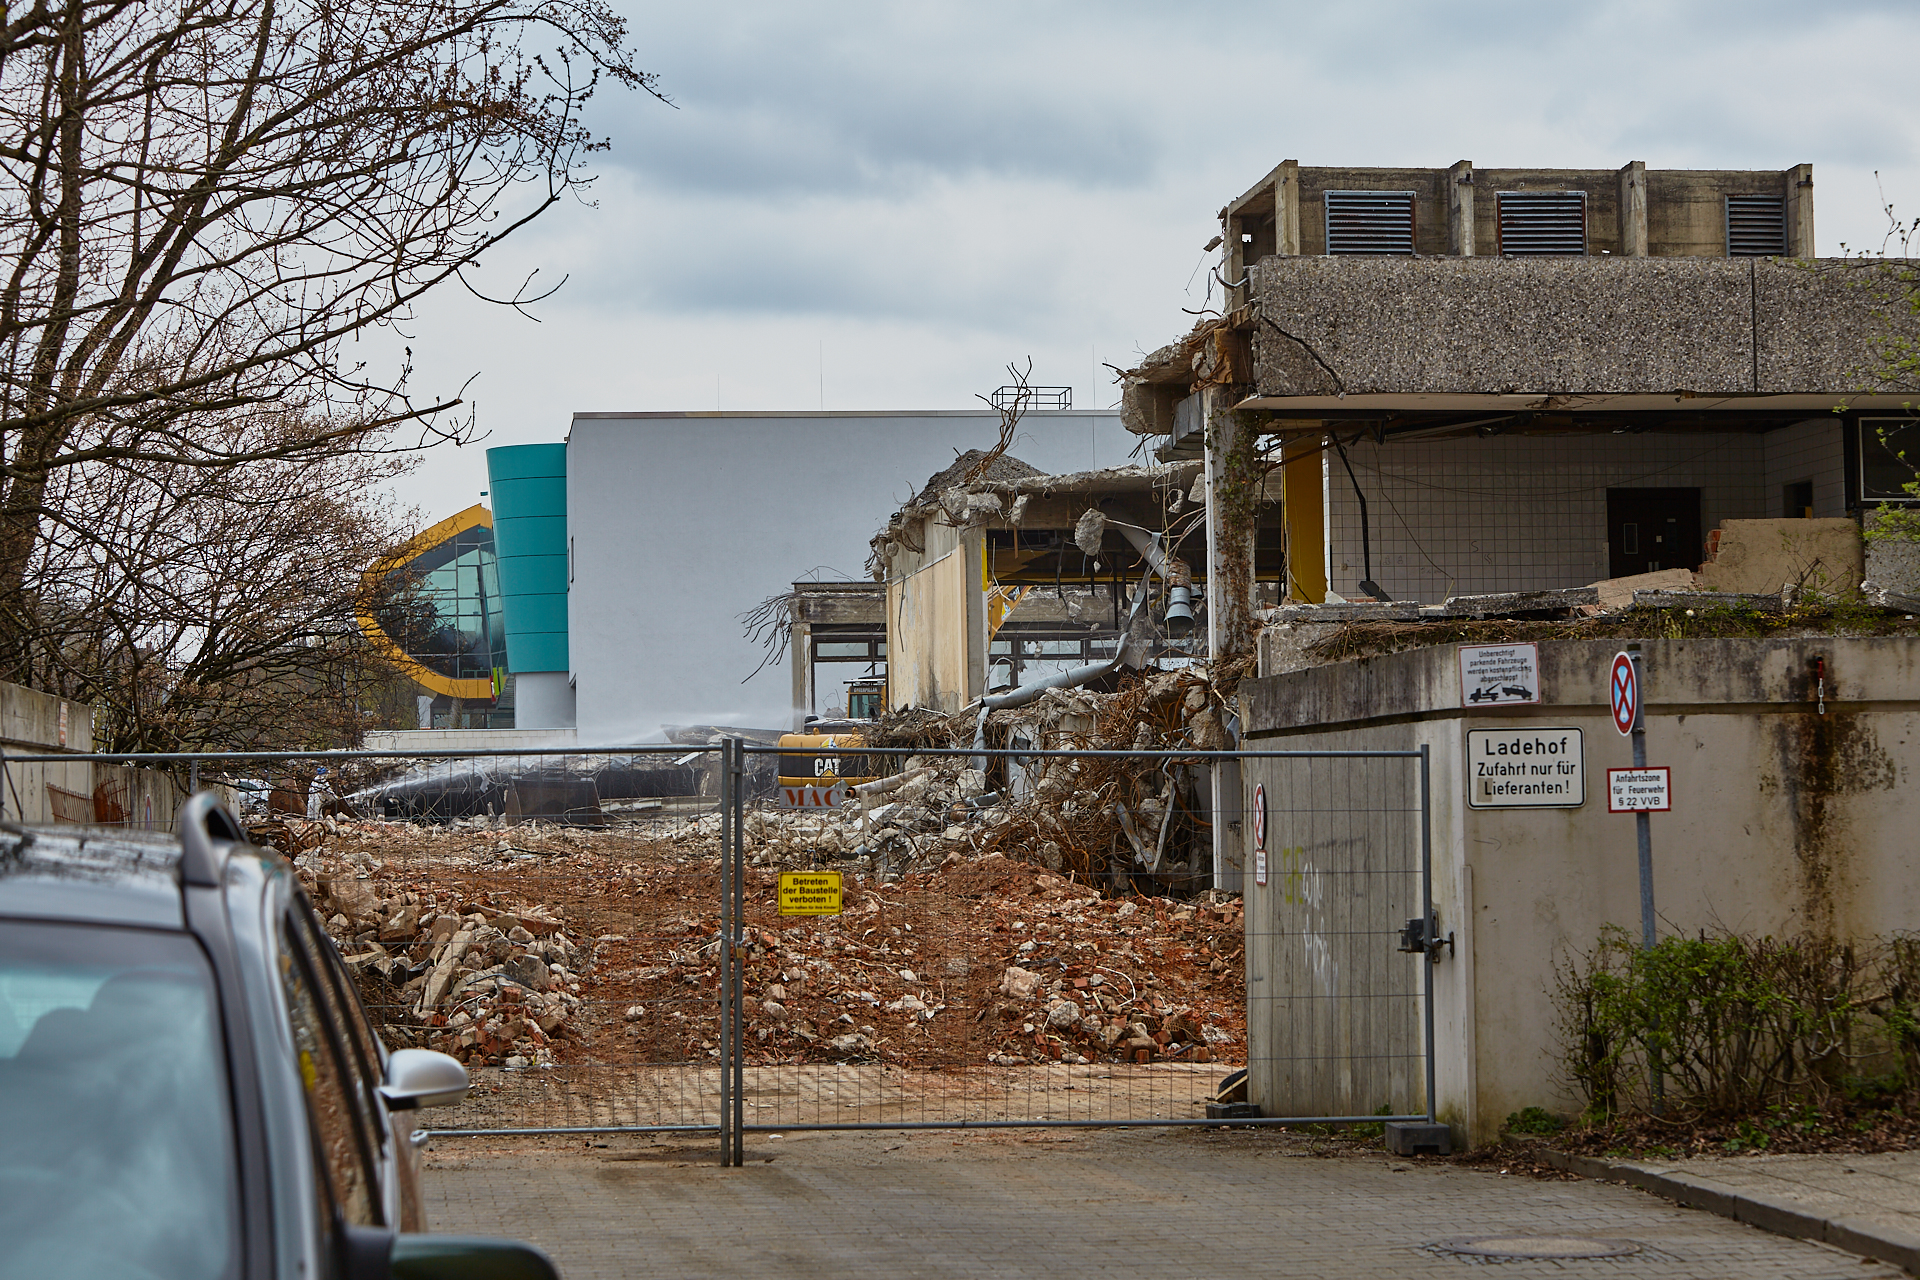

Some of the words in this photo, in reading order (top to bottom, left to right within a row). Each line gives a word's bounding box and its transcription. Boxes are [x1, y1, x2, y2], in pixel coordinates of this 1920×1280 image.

[1479, 649, 1515, 658] Unberechtigt
[1470, 658, 1496, 667] parkende
[1497, 657, 1528, 665] Fahrzeuge
[1467, 667, 1488, 675] werden
[1485, 737, 1567, 756] Ladehof
[814, 757, 841, 777] CAT
[1477, 761, 1526, 776] Zufahrt
[1531, 765, 1553, 775] nur
[1556, 760, 1576, 775] für
[1615, 774, 1661, 783] Anfahrtszone
[1484, 780, 1562, 795] Lieferanten
[1612, 785, 1623, 794] für
[1628, 785, 1665, 794] Feuerwehr
[782, 788, 840, 807] MAC
[1626, 797, 1637, 806] 22
[1640, 796, 1660, 805] VVB
[792, 877, 828, 886] Betreten
[782, 886, 797, 894] der
[799, 886, 838, 894] Baustelle
[789, 895, 827, 903] verboten
